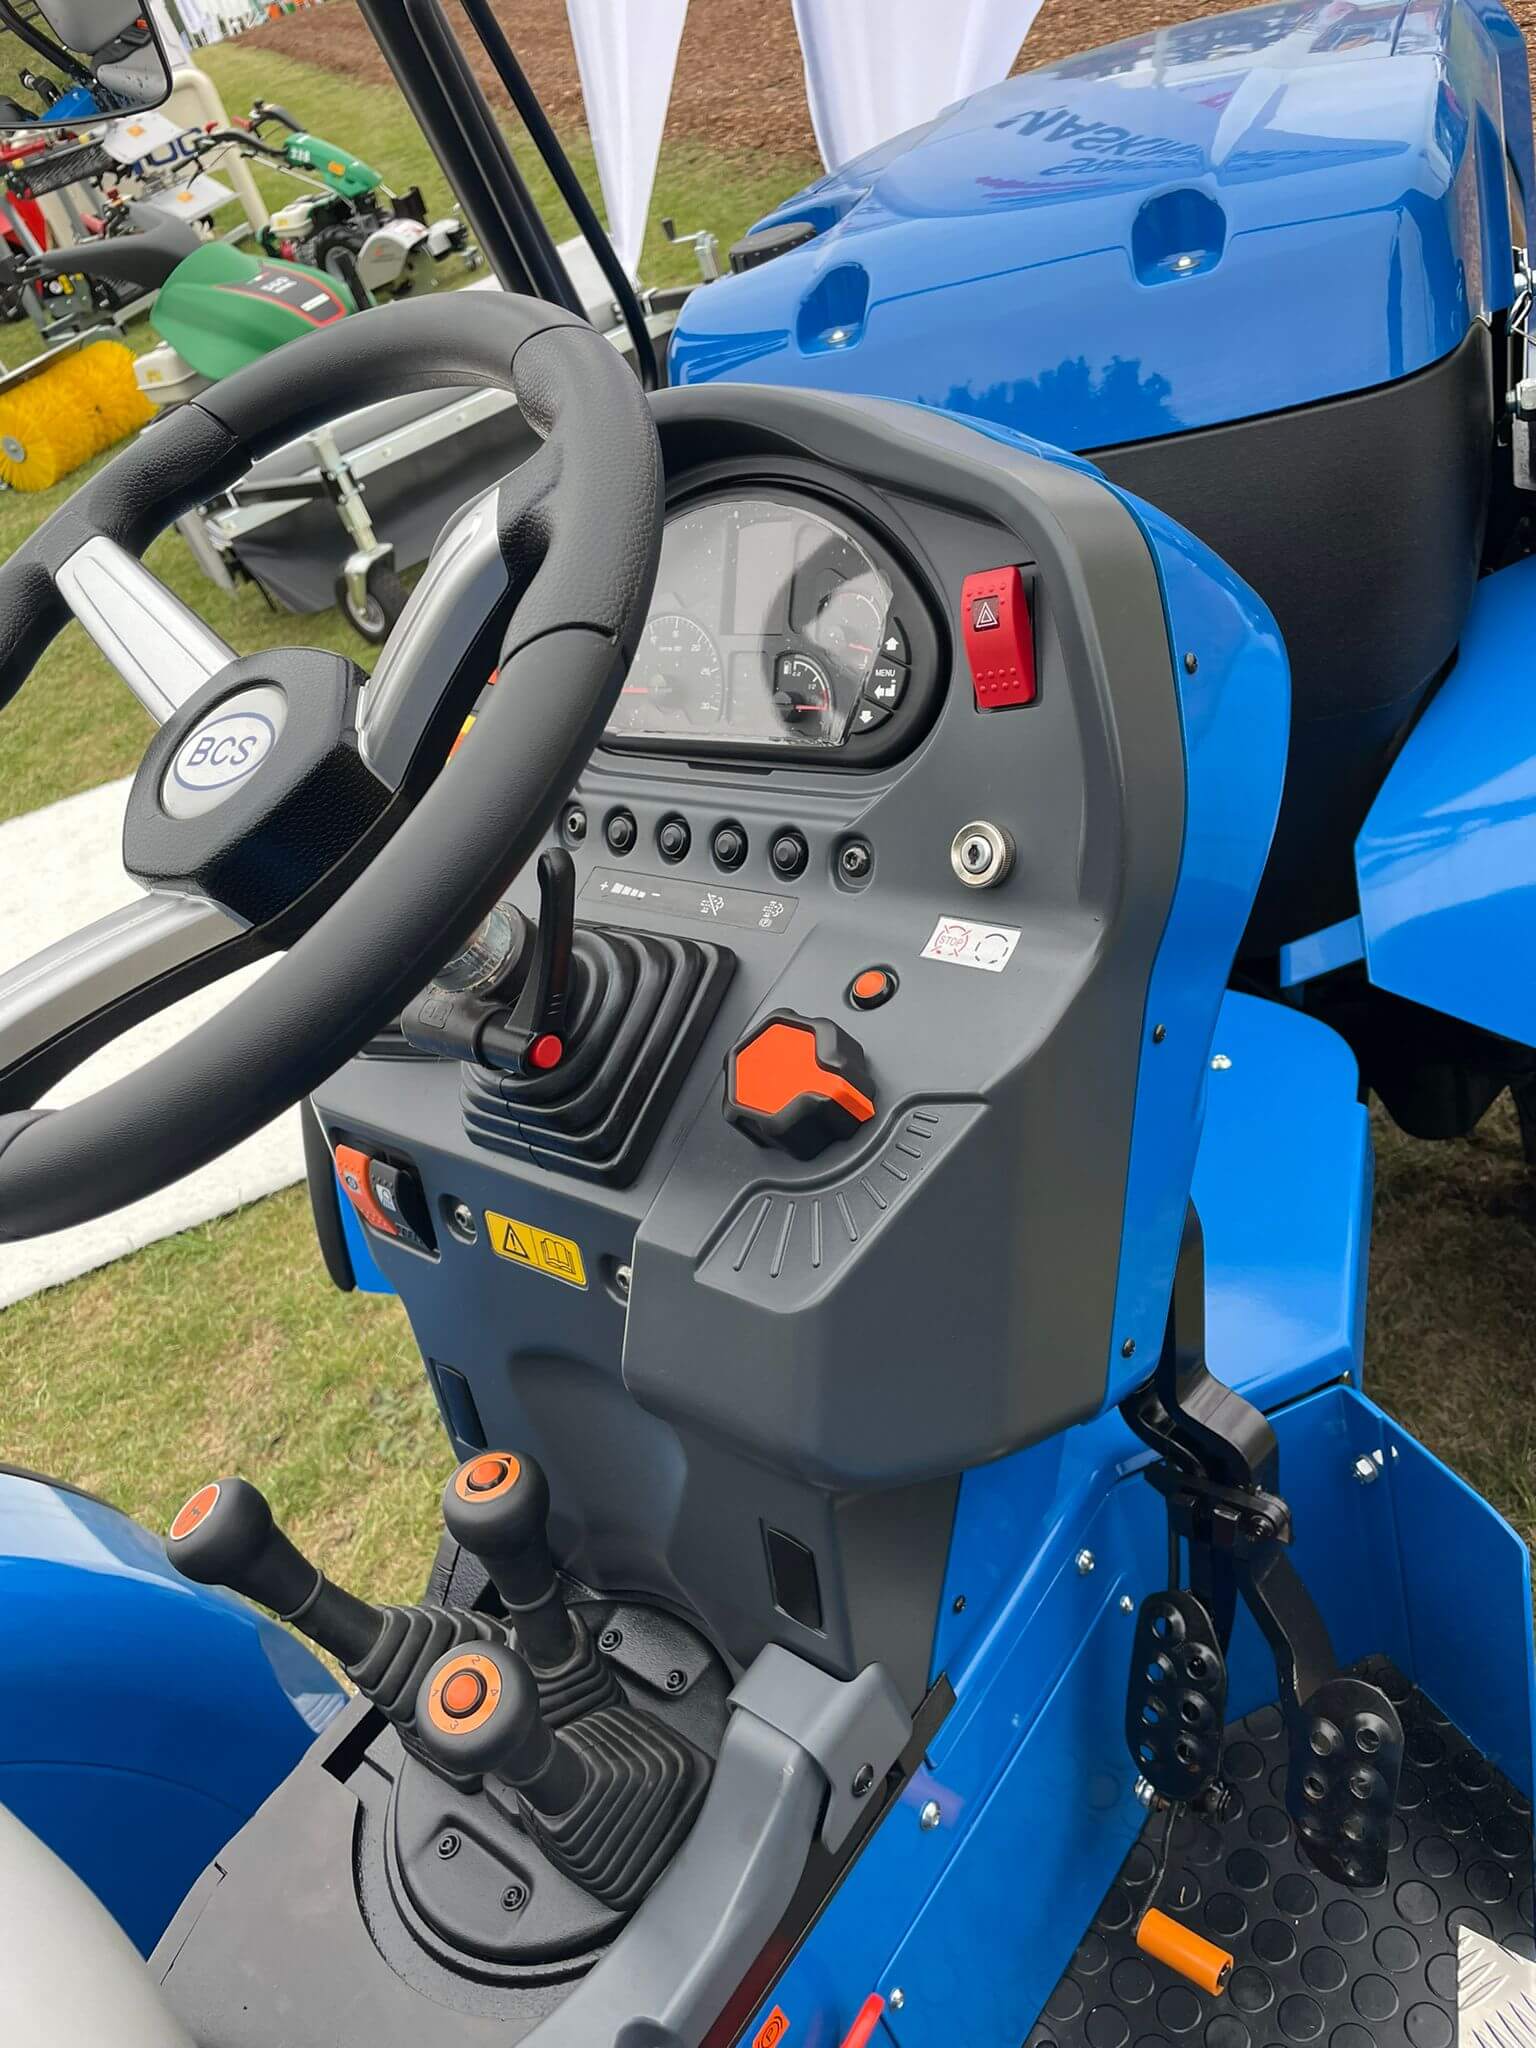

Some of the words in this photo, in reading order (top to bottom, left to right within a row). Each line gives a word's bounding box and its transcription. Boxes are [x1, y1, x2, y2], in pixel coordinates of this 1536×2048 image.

[875, 669, 896, 677] MENU
[186, 735, 258, 767] BCS
[938, 935, 963, 946] STOP
